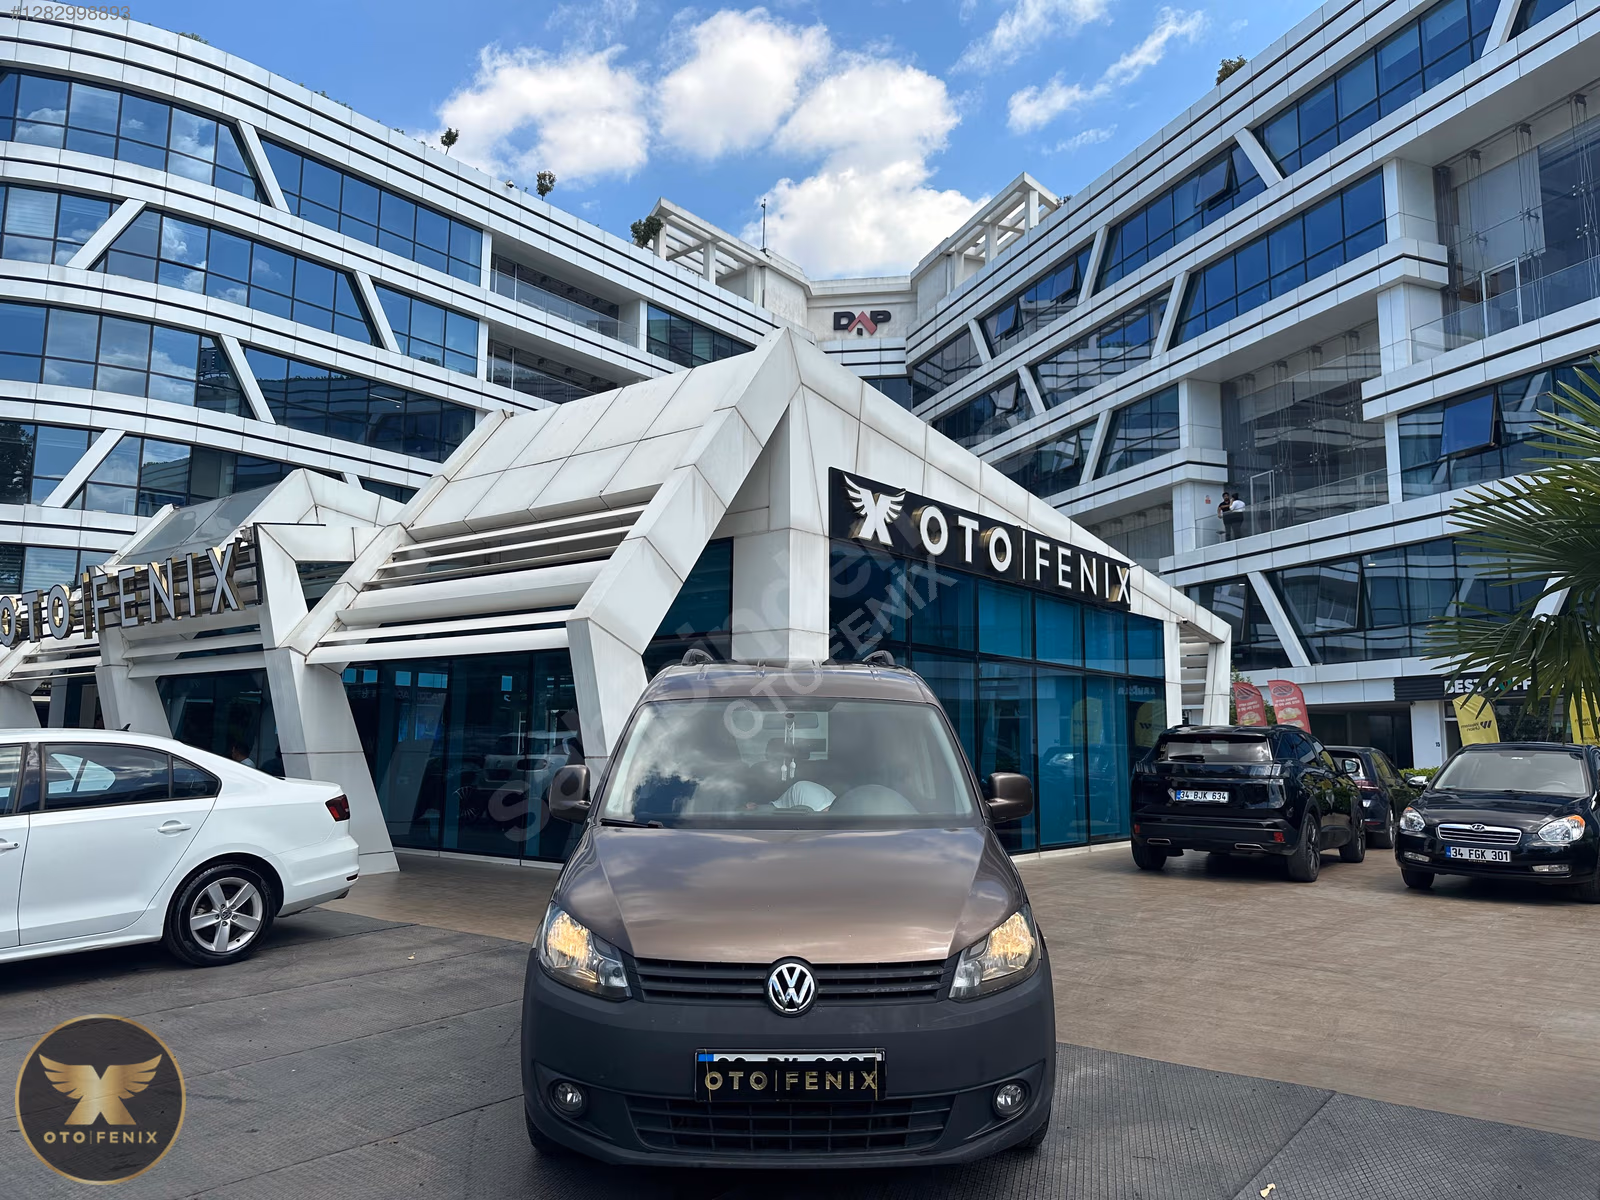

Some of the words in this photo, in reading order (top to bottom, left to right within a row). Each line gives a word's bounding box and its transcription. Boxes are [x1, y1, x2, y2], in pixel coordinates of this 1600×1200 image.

[917, 504, 1013, 572] OTO
[1035, 538, 1131, 605] FENIX
[0, 584, 71, 647] OTO
[92, 542, 241, 632] FENIX
[1181, 791, 1190, 799] 34
[1212, 792, 1226, 800] 634
[1452, 848, 1463, 857] 34
[1469, 849, 1486, 860] FGK
[1491, 851, 1508, 861] 301
[704, 1070, 768, 1091] OTO
[785, 1070, 878, 1091] FENIX
